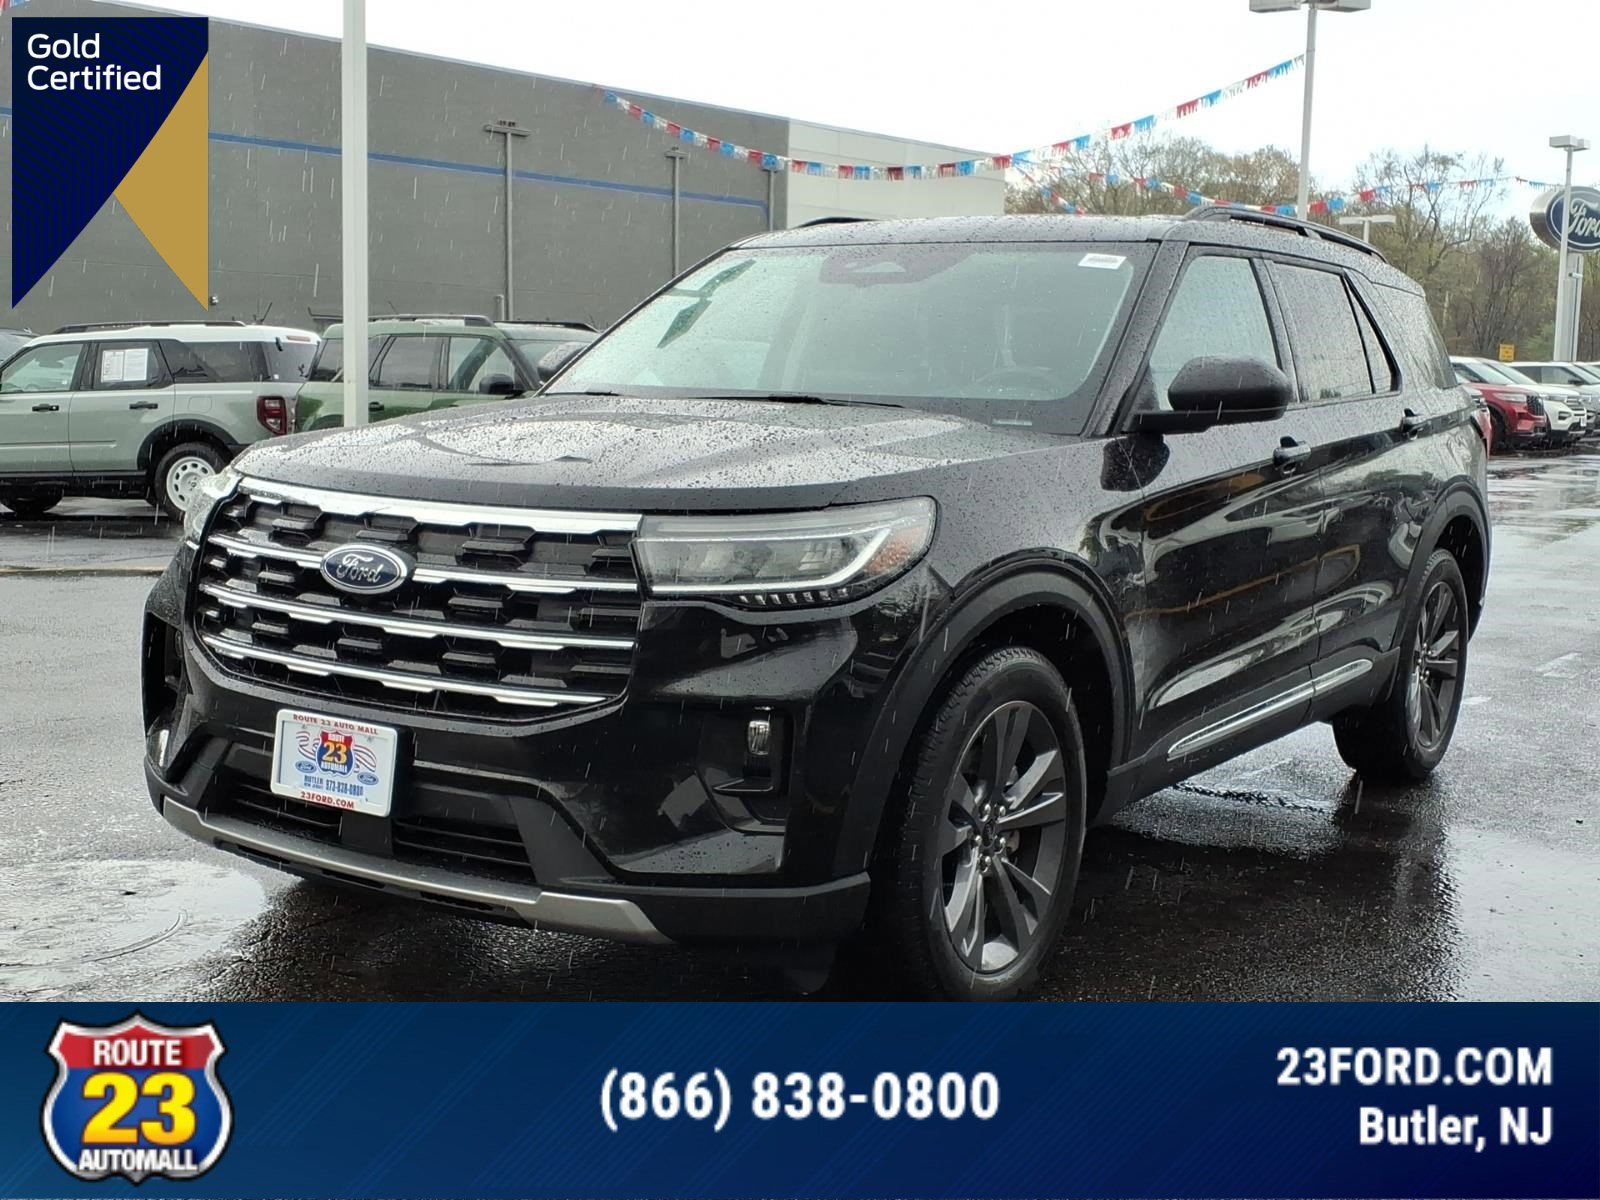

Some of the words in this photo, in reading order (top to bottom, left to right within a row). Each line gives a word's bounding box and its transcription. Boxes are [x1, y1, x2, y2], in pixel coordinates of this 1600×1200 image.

[335, 553, 384, 583] Ford
[293, 713, 318, 724] ROUTE
[321, 718, 332, 726] 23
[334, 720, 355, 731] AUTO
[357, 725, 379, 735] MALL
[321, 741, 348, 765] 23
[300, 790, 355, 809] 23FORD.COM
